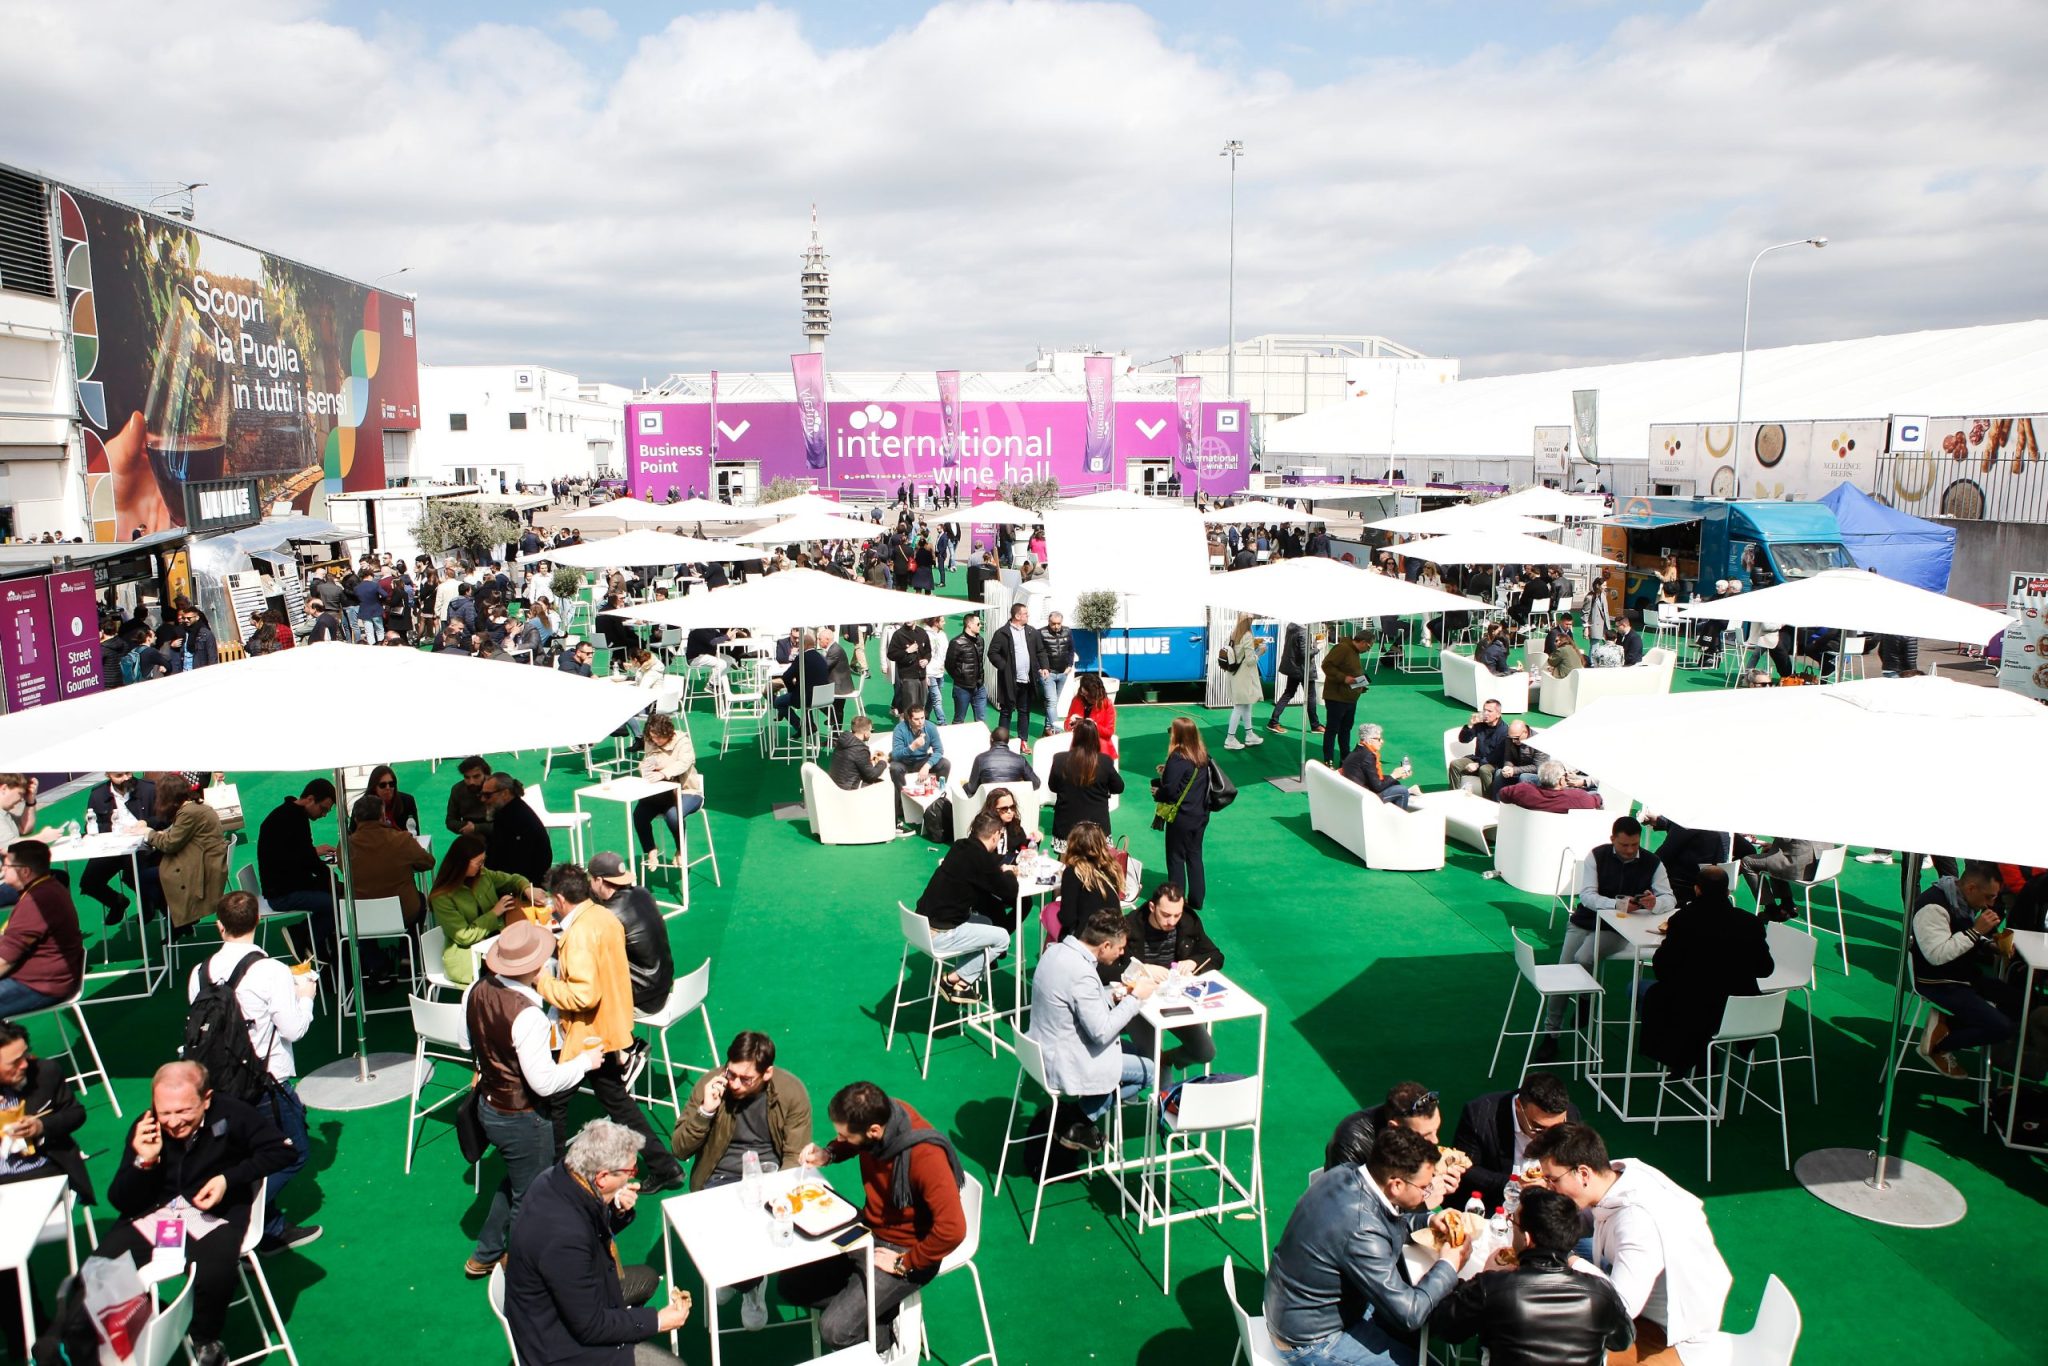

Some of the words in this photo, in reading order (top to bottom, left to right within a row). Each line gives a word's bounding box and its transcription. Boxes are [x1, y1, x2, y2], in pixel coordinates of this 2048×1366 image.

[194, 275, 264, 328] Scopri
[214, 327, 235, 364] la
[240, 332, 300, 378] Puglia
[520, 375, 529, 383] 9
[231, 375, 250, 409] in
[255, 379, 294, 412] tutti
[297, 382, 302, 413] i
[306, 388, 348, 416] sensi
[644, 417, 657, 428] D
[1222, 416, 1234, 425] D
[1901, 425, 1919, 442] C
[640, 443, 703, 457] Business
[837, 427, 1052, 458] interntional
[640, 459, 679, 474] Point
[933, 460, 993, 484] wine
[1004, 461, 1051, 485] hall
[1225, 462, 1238, 470] hall
[1830, 470, 1853, 478] BEERS
[68, 648, 92, 664] Street
[72, 661, 91, 678] Food
[66, 674, 99, 693] Gourmet
